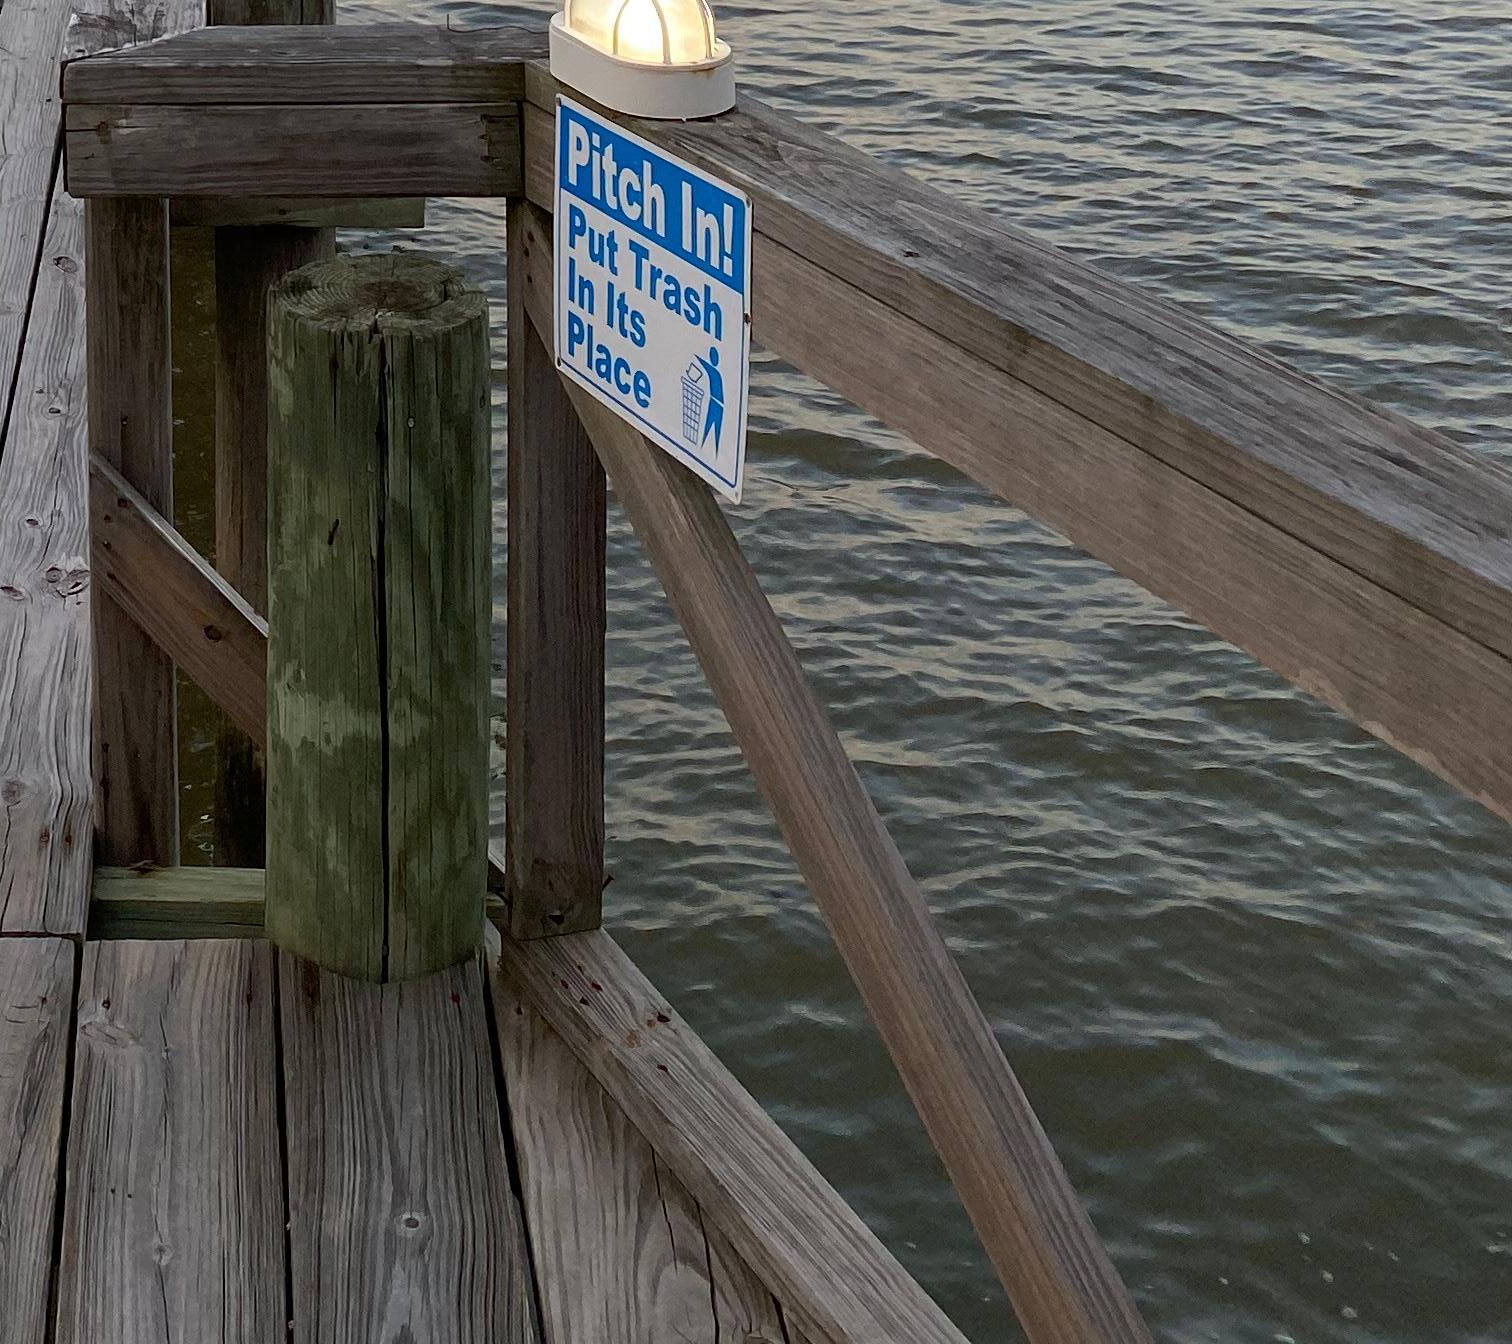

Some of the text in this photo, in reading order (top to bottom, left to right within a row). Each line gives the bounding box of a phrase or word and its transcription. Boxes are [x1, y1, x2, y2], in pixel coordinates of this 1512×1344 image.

[568, 118, 734, 278] Pitch In!
[569, 203, 722, 342] Put Trash
[569, 257, 647, 349] In Its
[568, 311, 652, 409] Place
